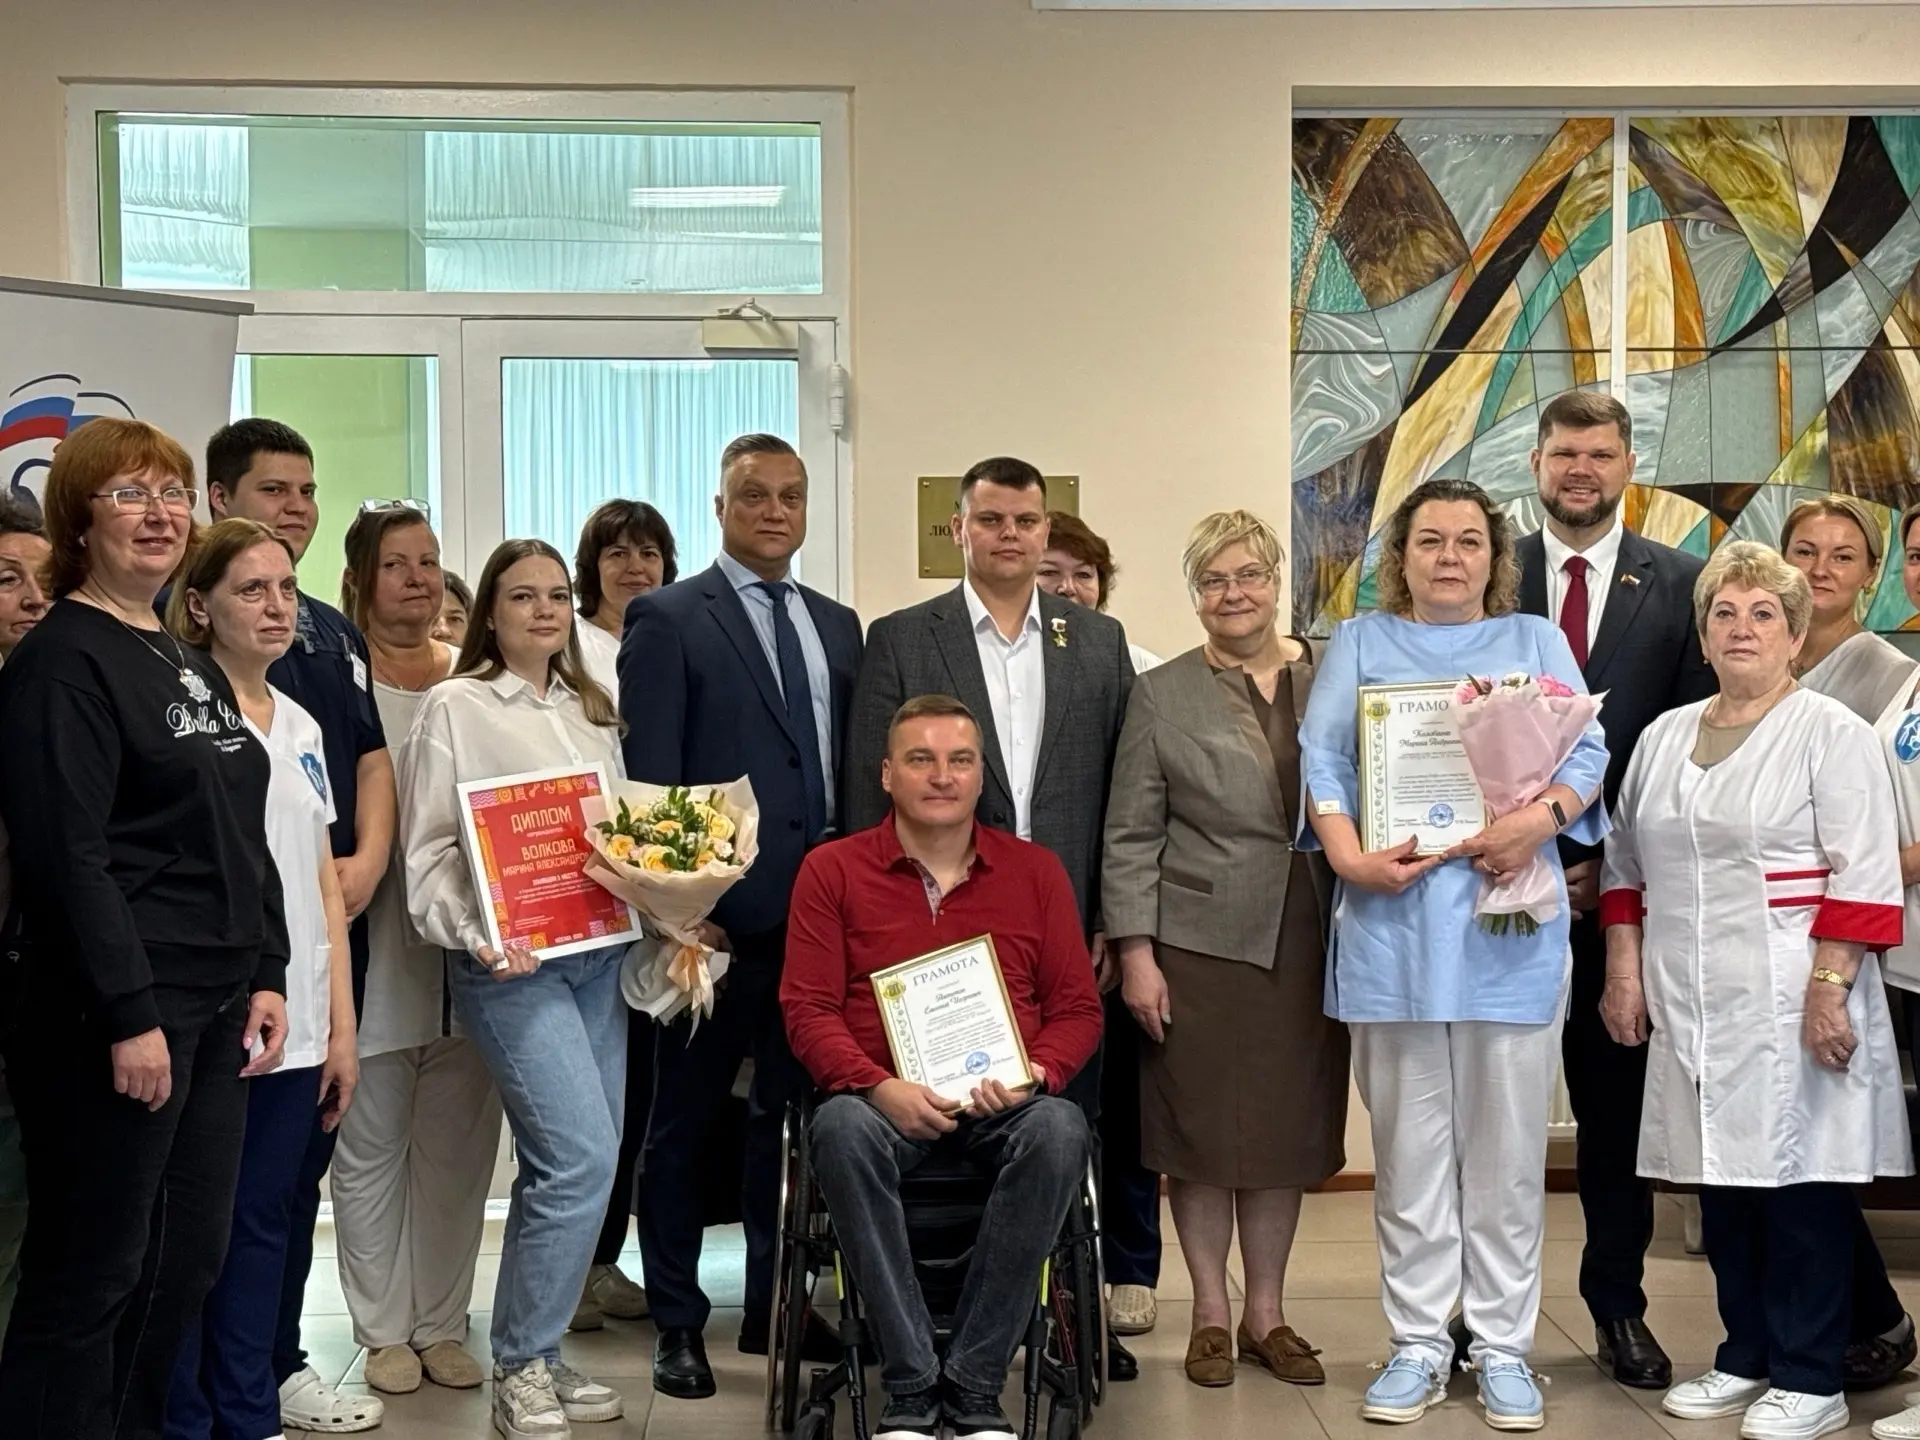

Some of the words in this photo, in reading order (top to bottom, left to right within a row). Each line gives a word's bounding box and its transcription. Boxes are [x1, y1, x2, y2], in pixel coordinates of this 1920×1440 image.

[1399, 700, 1450, 713] ГРАМО
[510, 805, 572, 833] ДИПЛОМ
[521, 838, 576, 861] ВОЛКОВА
[502, 862, 535, 877] МАРИНА
[913, 955, 979, 986] ГРАМОТА
